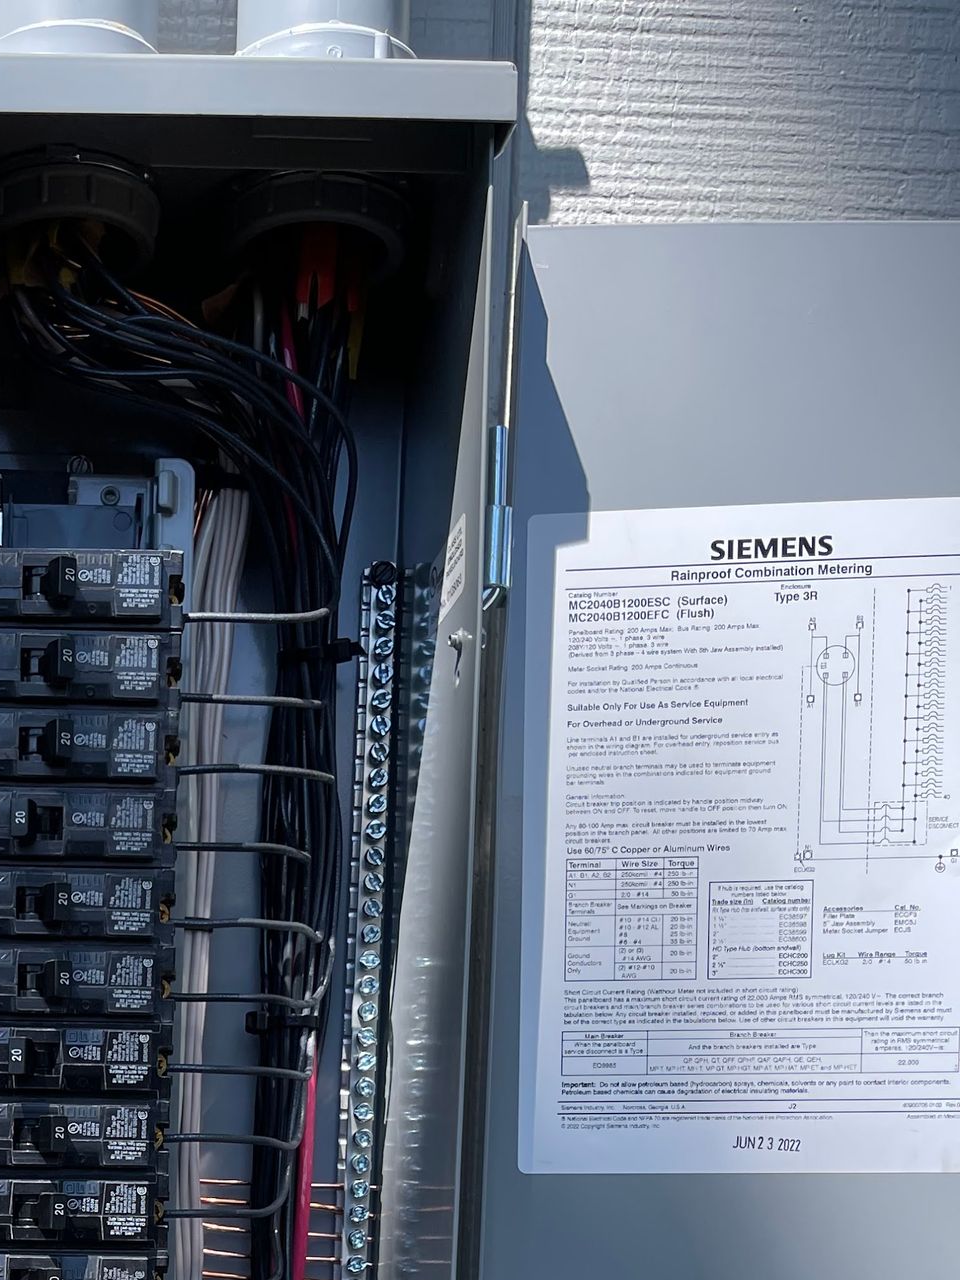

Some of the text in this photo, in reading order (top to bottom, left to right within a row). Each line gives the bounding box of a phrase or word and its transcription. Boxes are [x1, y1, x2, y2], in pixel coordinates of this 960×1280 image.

[710, 536, 833, 560] SIEMENS
[65, 568, 75, 581] 20
[671, 563, 873, 582] Rainproof Combination Metering
[677, 595, 728, 608] (Surface)
[774, 591, 818, 604] Type 3R
[676, 608, 715, 621] (Flush)
[63, 649, 73, 662] 20
[568, 703, 600, 711] Suitable
[603, 703, 622, 712] Only
[624, 702, 637, 710] For
[640, 702, 655, 710] Use
[671, 700, 701, 708] Service
[704, 699, 748, 708] Equipment
[568, 720, 580, 728] For
[583, 719, 622, 728] Overhead
[636, 718, 689, 726] Underground
[692, 717, 722, 725] Service
[61, 732, 71, 746] 20
[15, 811, 26, 824] 20
[620, 846, 650, 855] Copper
[664, 845, 705, 853] Aluminum
[706, 844, 730, 852] Wires
[668, 860, 694, 868] Torque
[58, 893, 68, 905] 20
[60, 972, 69, 985] 20
[11, 1048, 22, 1062] 20
[55, 1126, 64, 1139] 20
[733, 1136, 755, 1149] JUN
[778, 1139, 801, 1152] 2022
[55, 1203, 64, 1216] 20
